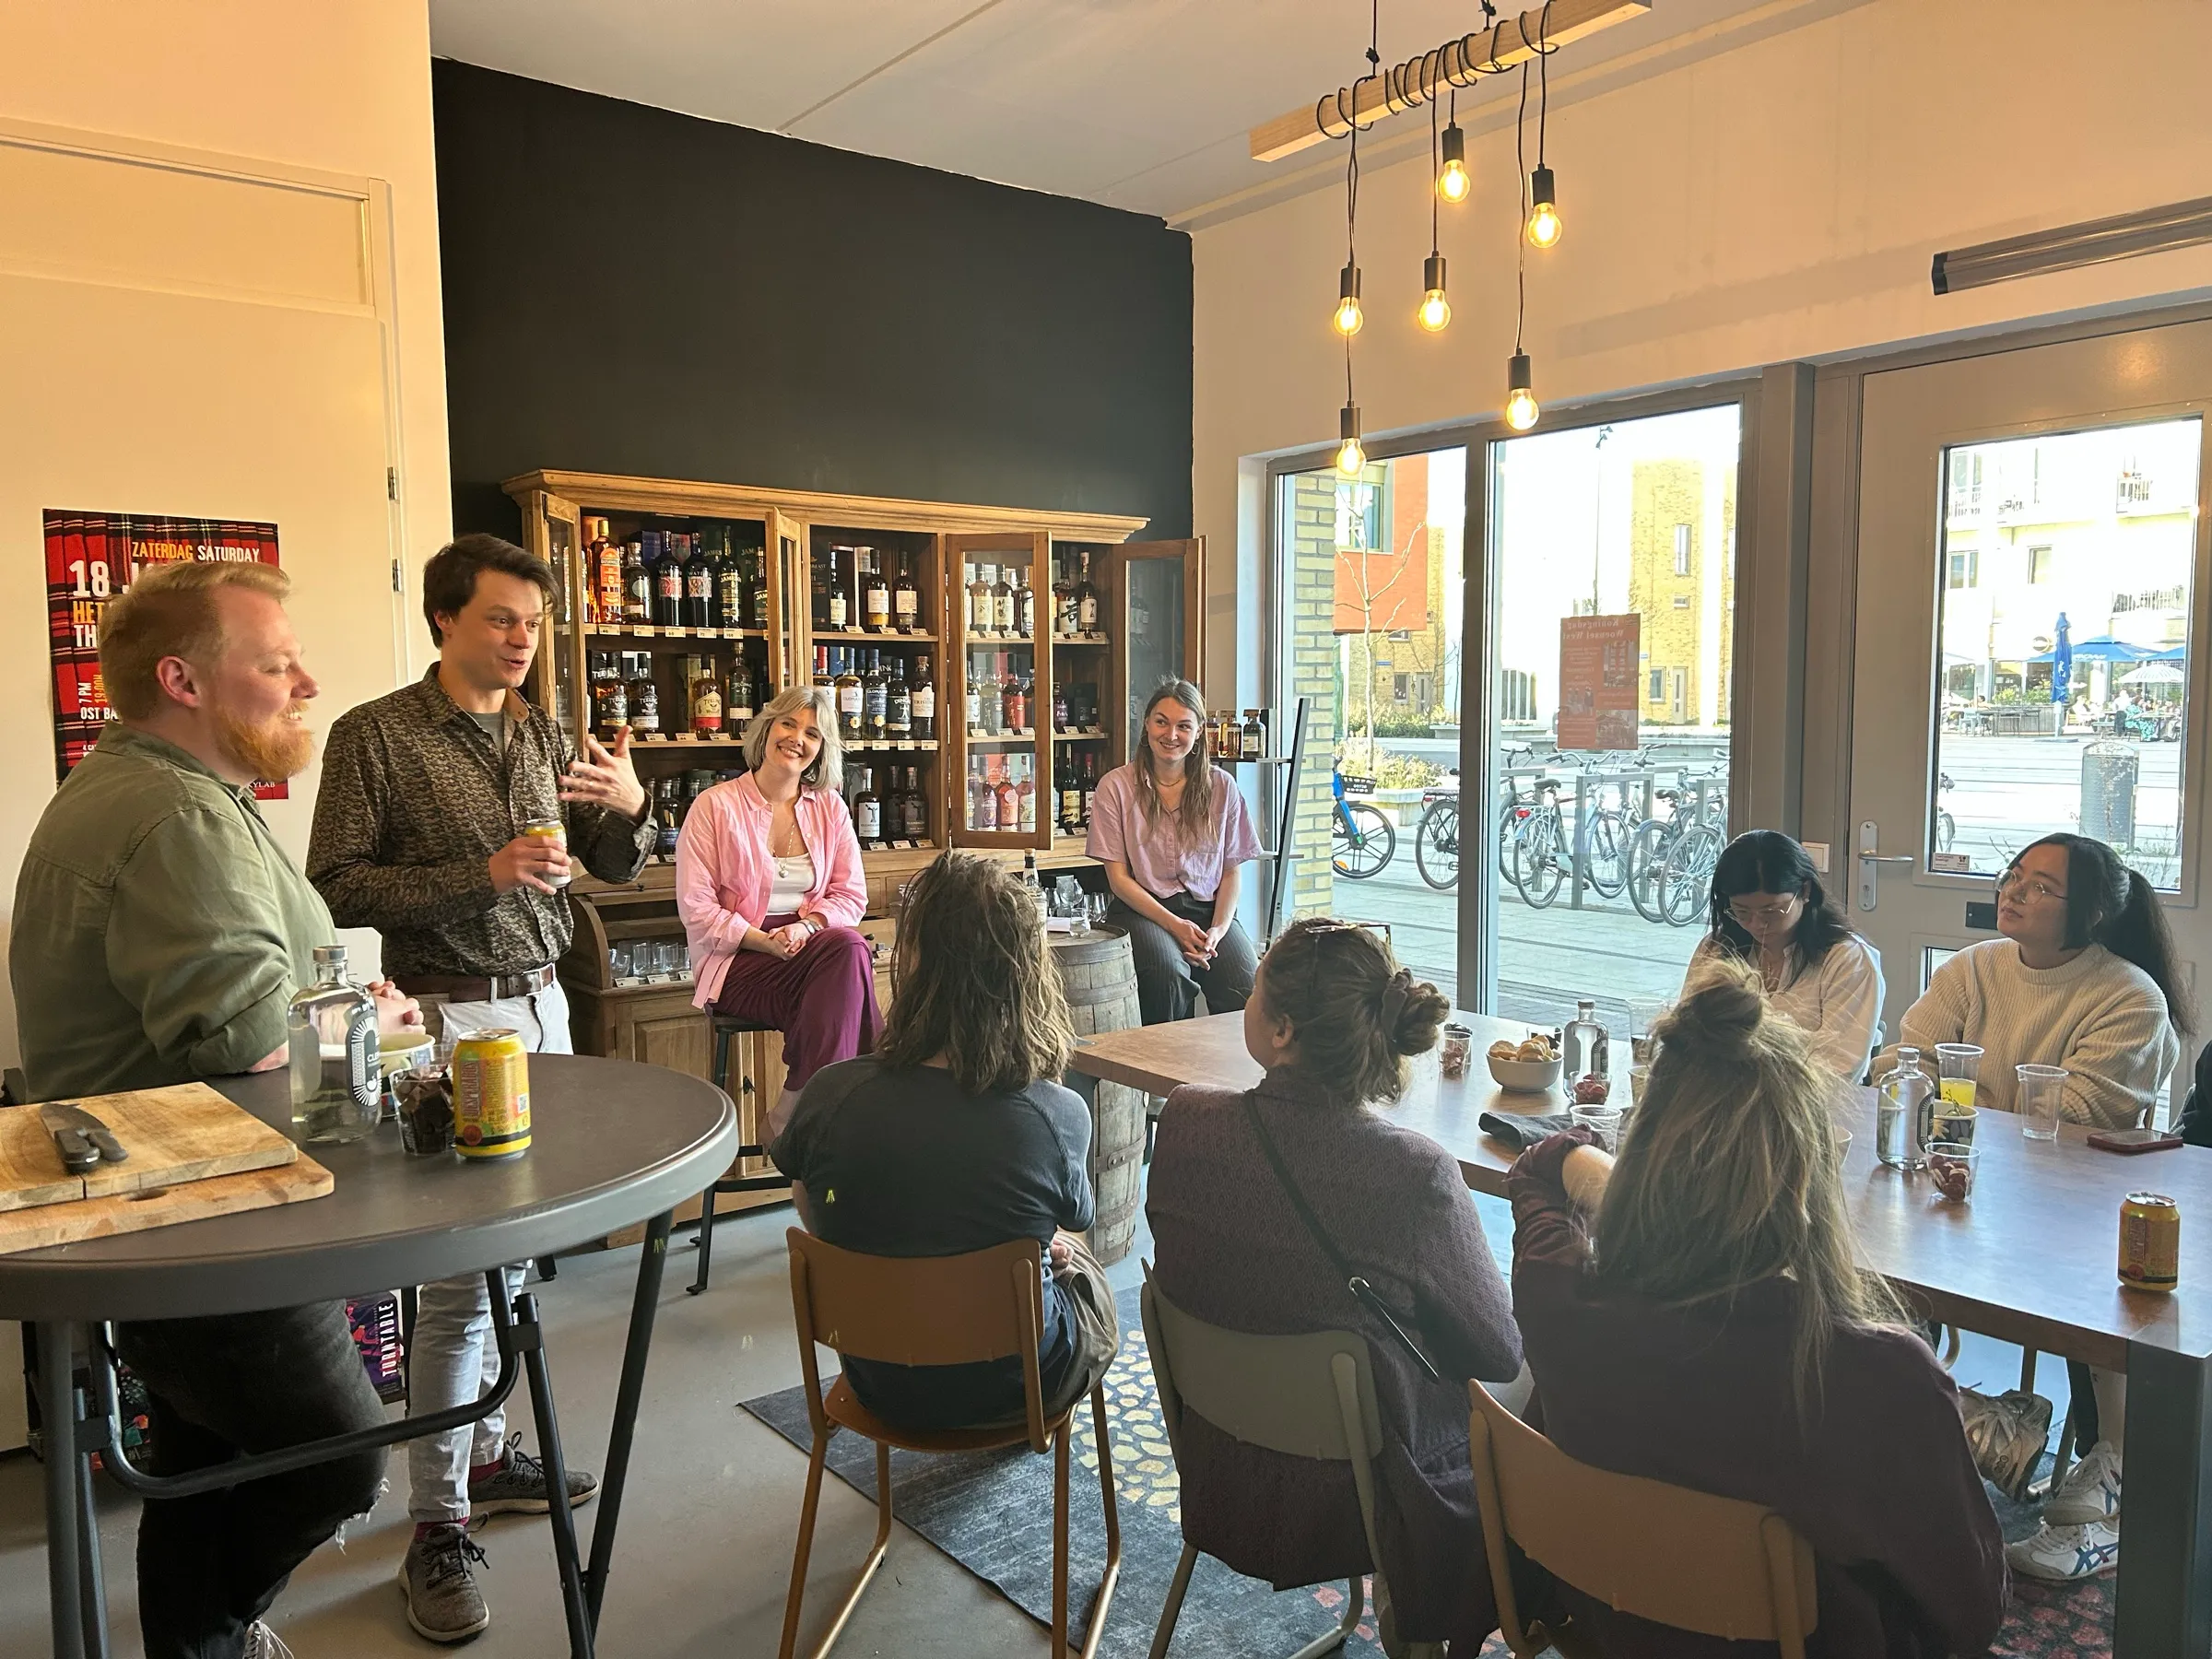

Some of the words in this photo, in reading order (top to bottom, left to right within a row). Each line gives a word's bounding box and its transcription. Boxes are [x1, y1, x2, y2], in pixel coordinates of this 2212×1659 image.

[132, 542, 194, 560] ZATERDAG
[197, 545, 260, 563] SATURDAY
[69, 559, 110, 597] 18
[74, 624, 98, 647] TH
[77, 682, 92, 696] PM
[378, 1303, 397, 1378] TURNTABLE
